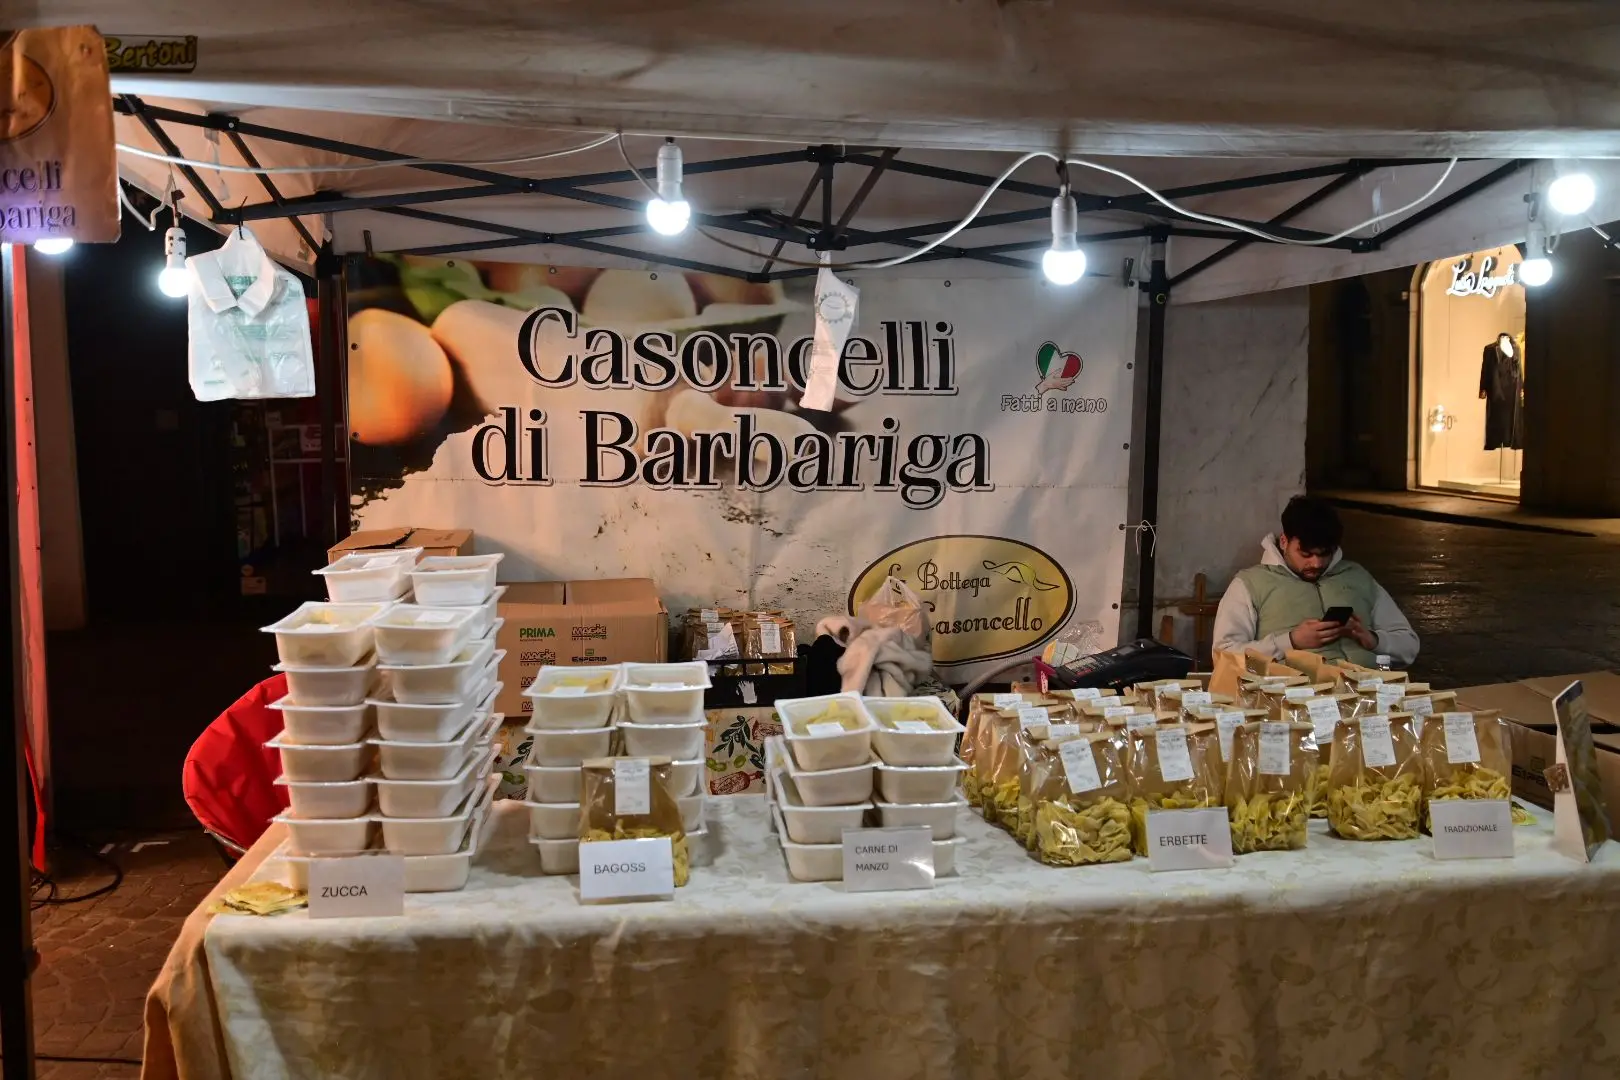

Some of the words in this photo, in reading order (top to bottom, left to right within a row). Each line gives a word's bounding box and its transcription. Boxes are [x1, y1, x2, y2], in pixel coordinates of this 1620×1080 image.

[104, 35, 197, 68] Bertoni
[1000, 393, 1042, 412] Fatti
[1046, 397, 1058, 412] a
[1061, 397, 1108, 413] mano
[471, 406, 553, 488] di
[579, 409, 995, 510] Barbariga
[917, 558, 992, 597] Bottega
[519, 627, 556, 638] PRIMA
[1444, 823, 1498, 833] TRADIZIONALE
[1159, 833, 1208, 848] ERBETTE
[854, 844, 884, 855] CARNE
[887, 844, 898, 854] DI
[593, 861, 646, 875] BAGOSS
[855, 862, 889, 872] MANZO
[321, 884, 368, 898] ZUCCA
